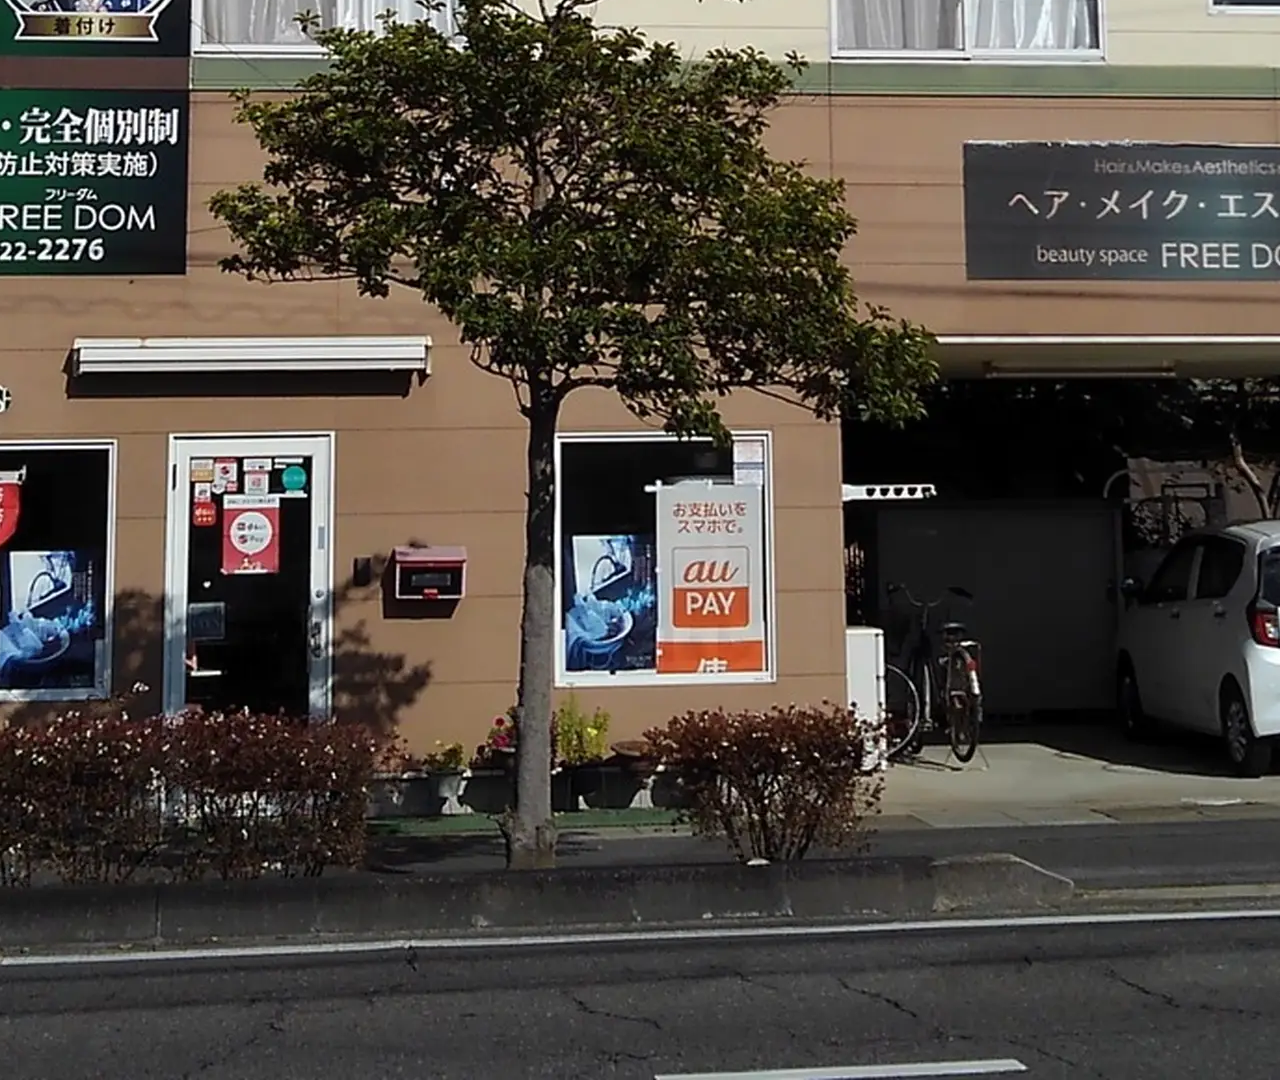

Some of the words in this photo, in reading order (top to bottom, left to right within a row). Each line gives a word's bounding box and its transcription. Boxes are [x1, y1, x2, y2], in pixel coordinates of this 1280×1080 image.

[53, 18, 117, 36] 着付け
[44, 188, 98, 202] フリーダム
[74, 203, 157, 231] DOM
[1036, 244, 1096, 267] beauty
[1099, 248, 1149, 267] space
[1161, 242, 1240, 269] FREE
[672, 502, 747, 518] お支払いを
[677, 519, 743, 534] スマホで。
[683, 559, 740, 583] au
[685, 591, 736, 616] PAY
